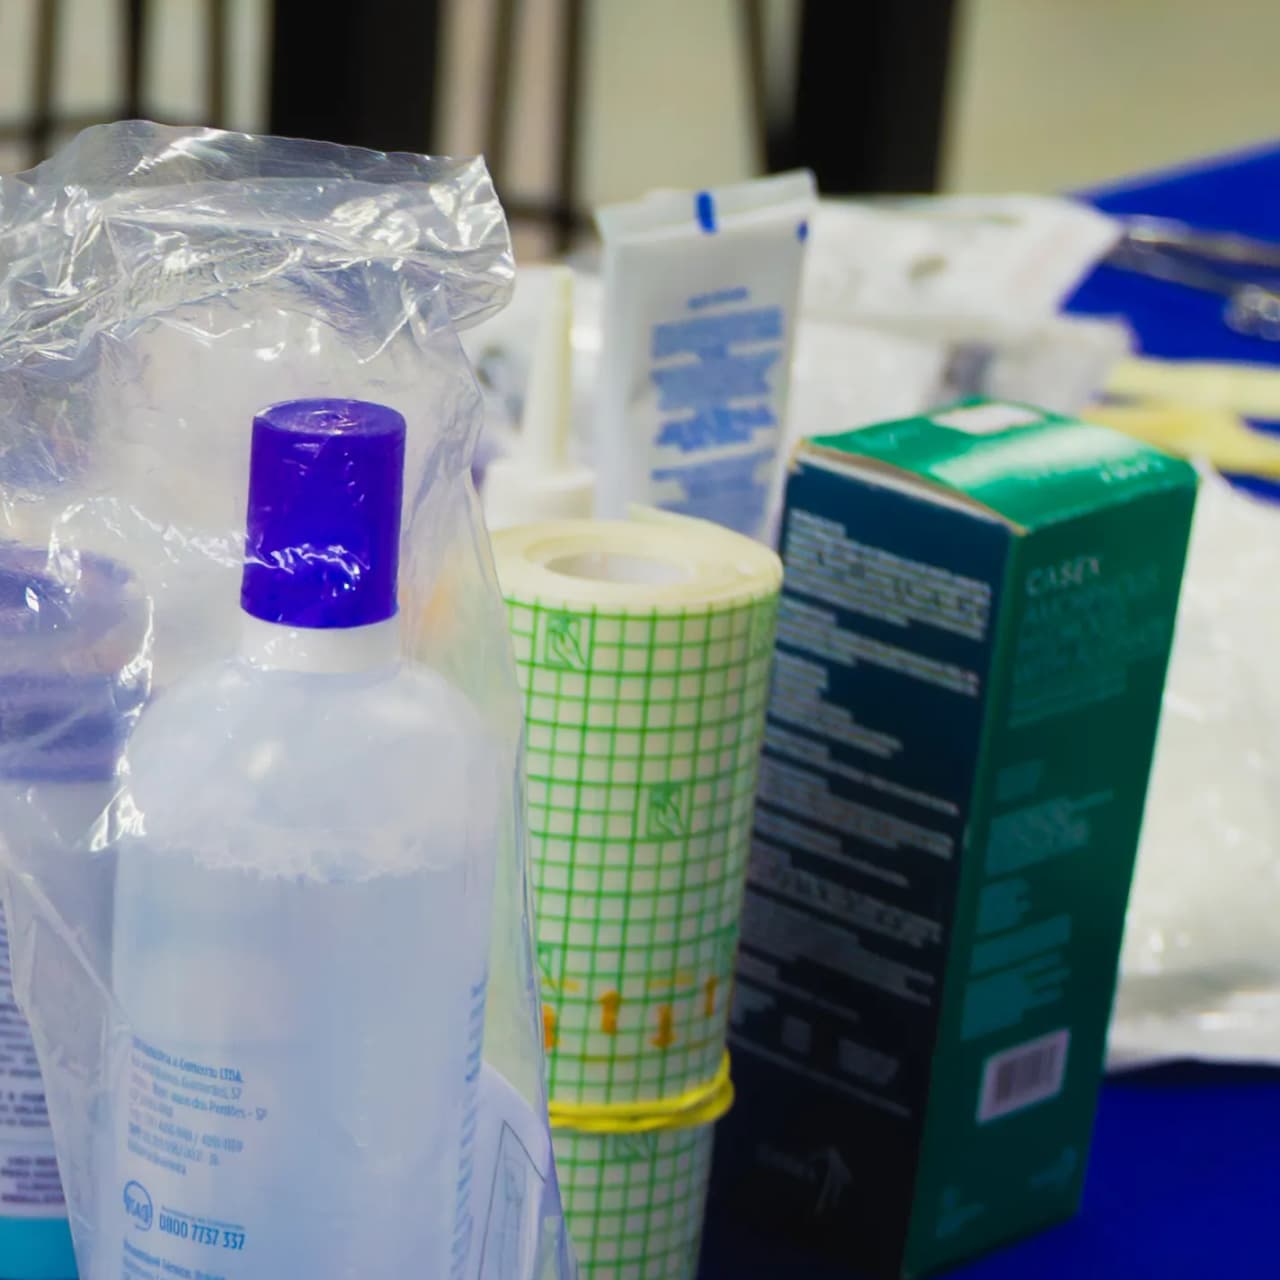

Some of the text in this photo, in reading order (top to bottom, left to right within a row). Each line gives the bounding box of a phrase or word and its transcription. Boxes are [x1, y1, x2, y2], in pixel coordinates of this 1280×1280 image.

[159, 1213, 189, 1239] 0800
[191, 1223, 220, 1247] 7737
[223, 1231, 246, 1250] 337
